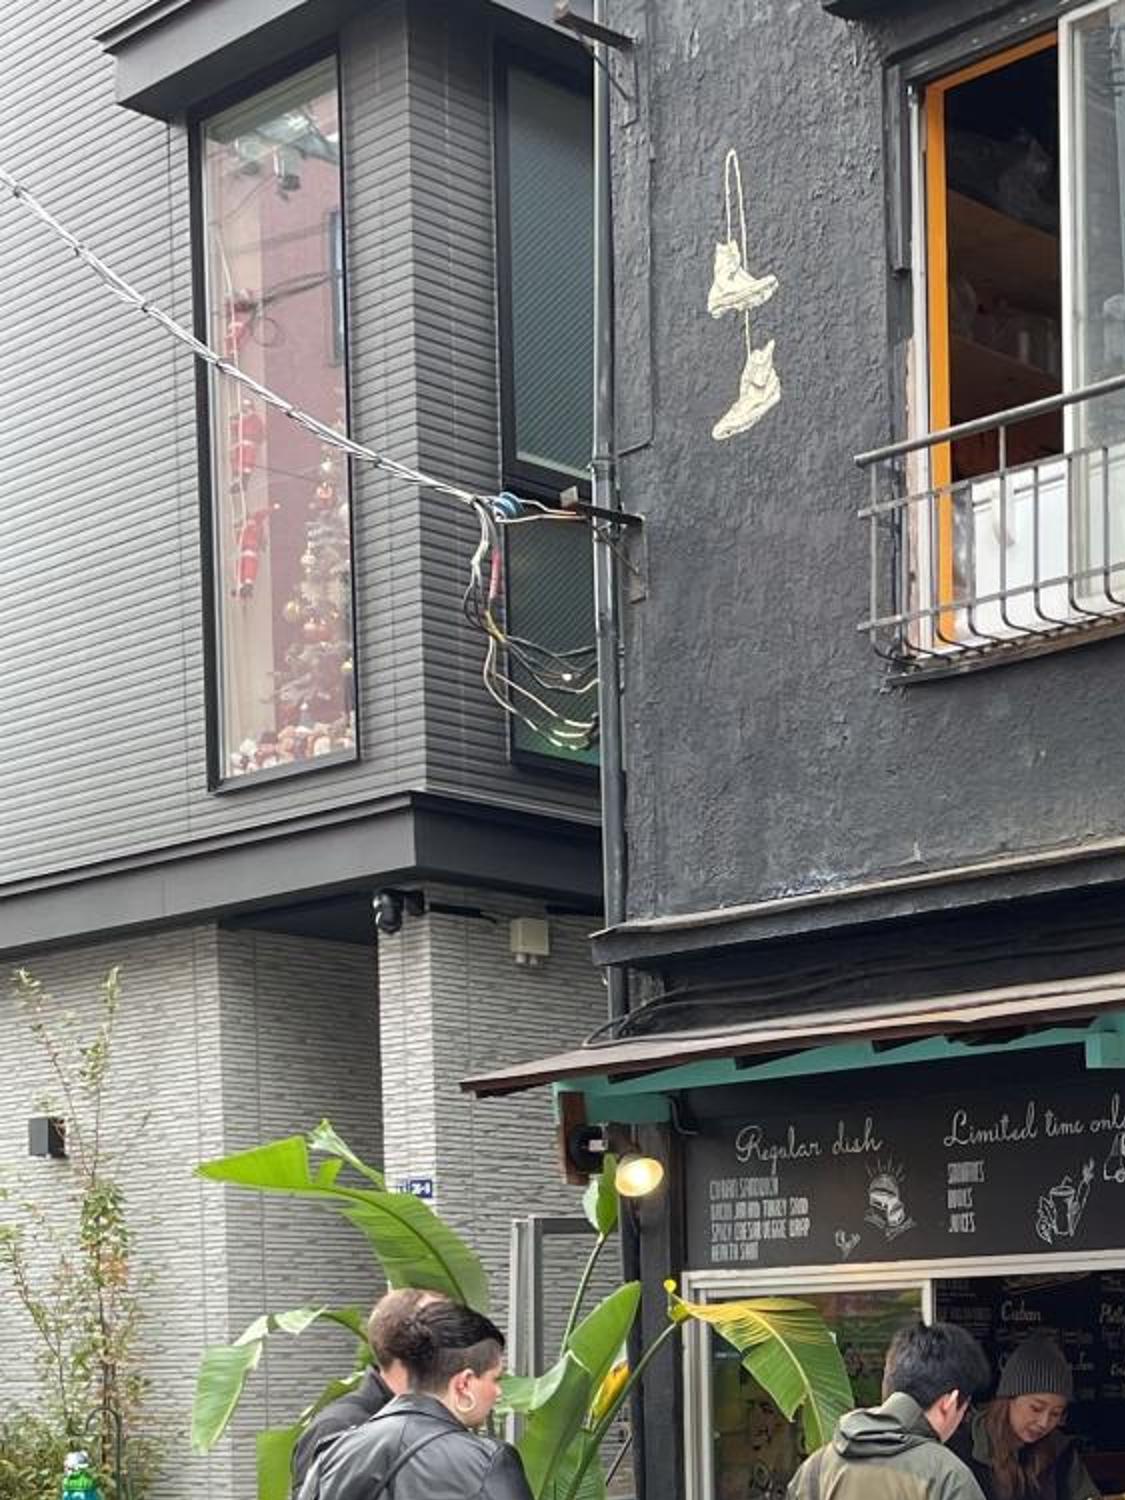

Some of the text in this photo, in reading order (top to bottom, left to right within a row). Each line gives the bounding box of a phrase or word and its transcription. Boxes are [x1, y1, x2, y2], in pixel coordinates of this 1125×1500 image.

[736, 1117, 884, 1176] Regular dish
[943, 1100, 1039, 1147] Limited
[1045, 1109, 1084, 1137] time
